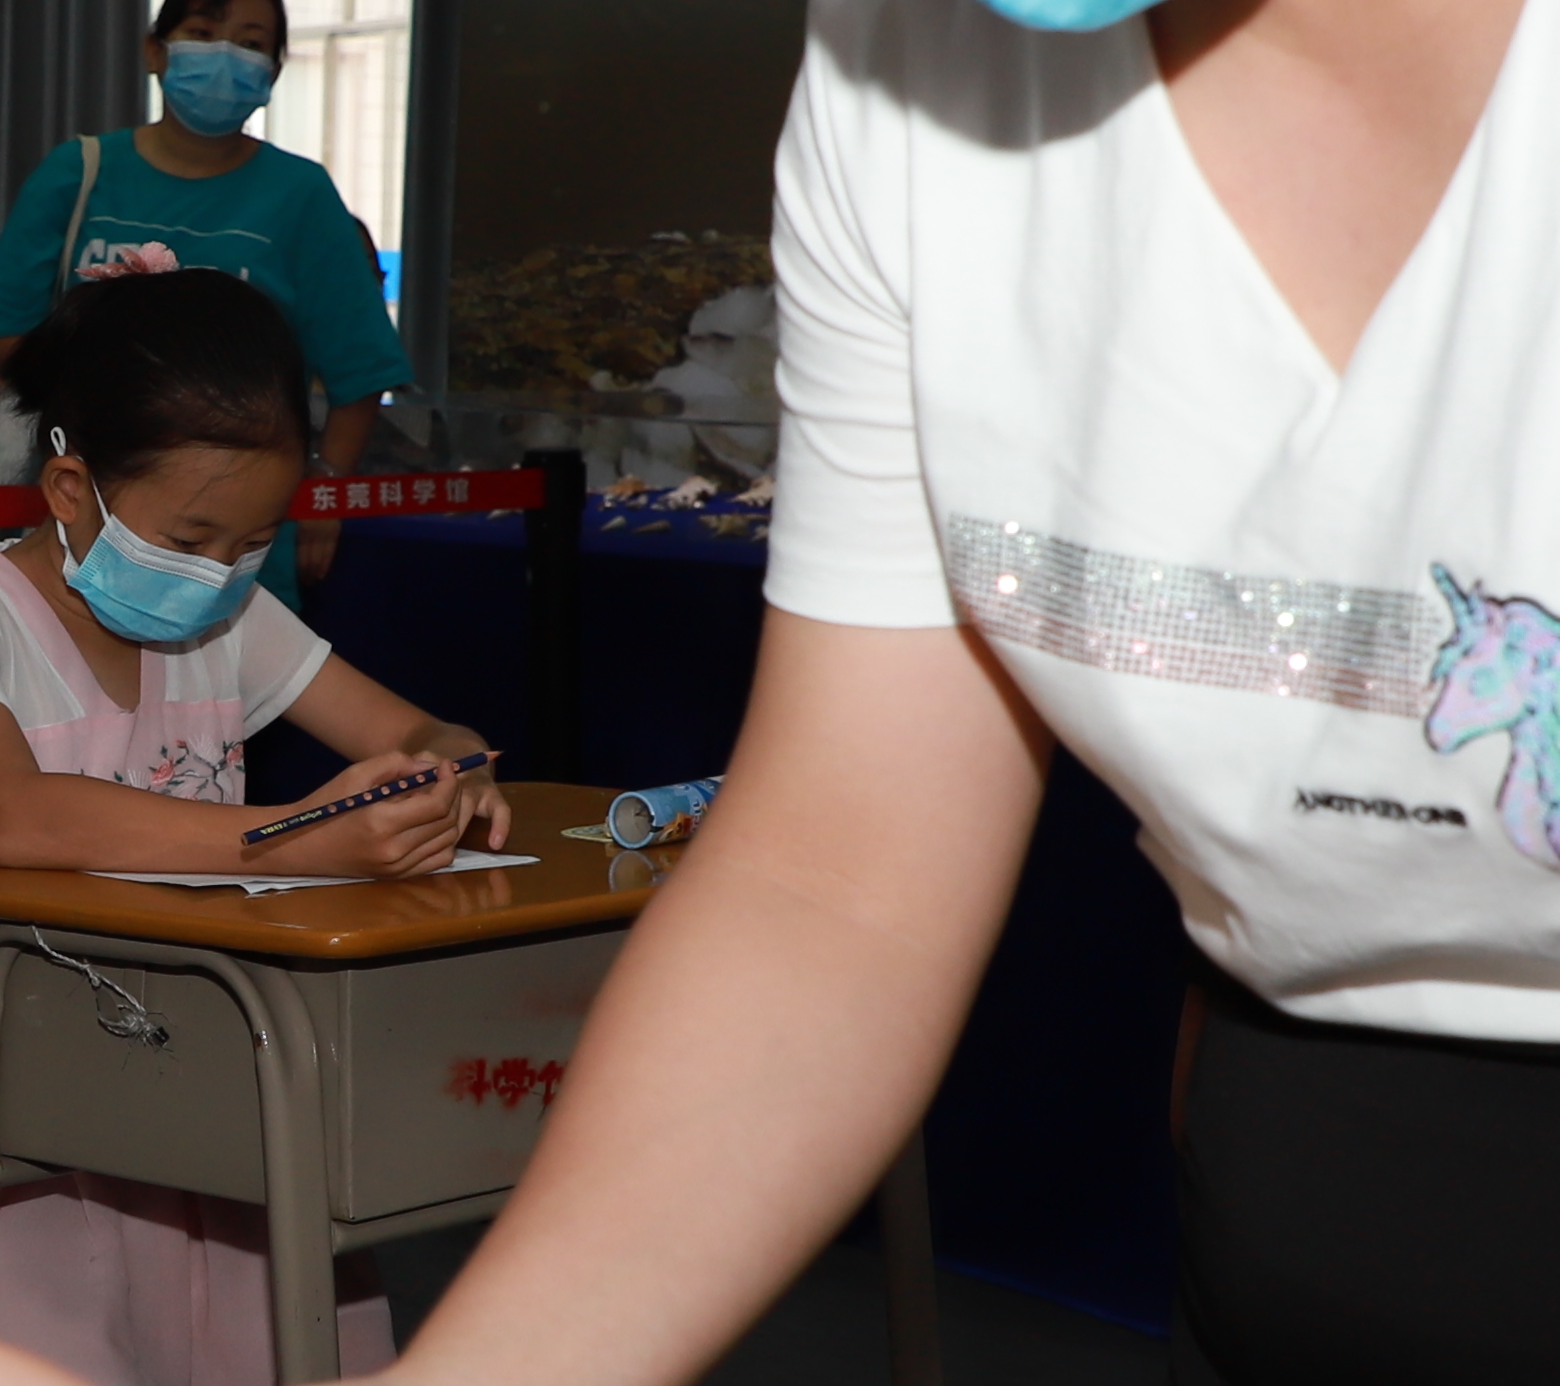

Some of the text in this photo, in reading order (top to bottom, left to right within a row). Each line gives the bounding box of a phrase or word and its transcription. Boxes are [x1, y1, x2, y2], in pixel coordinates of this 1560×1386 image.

[310, 475, 471, 512] 东莞科学馆
